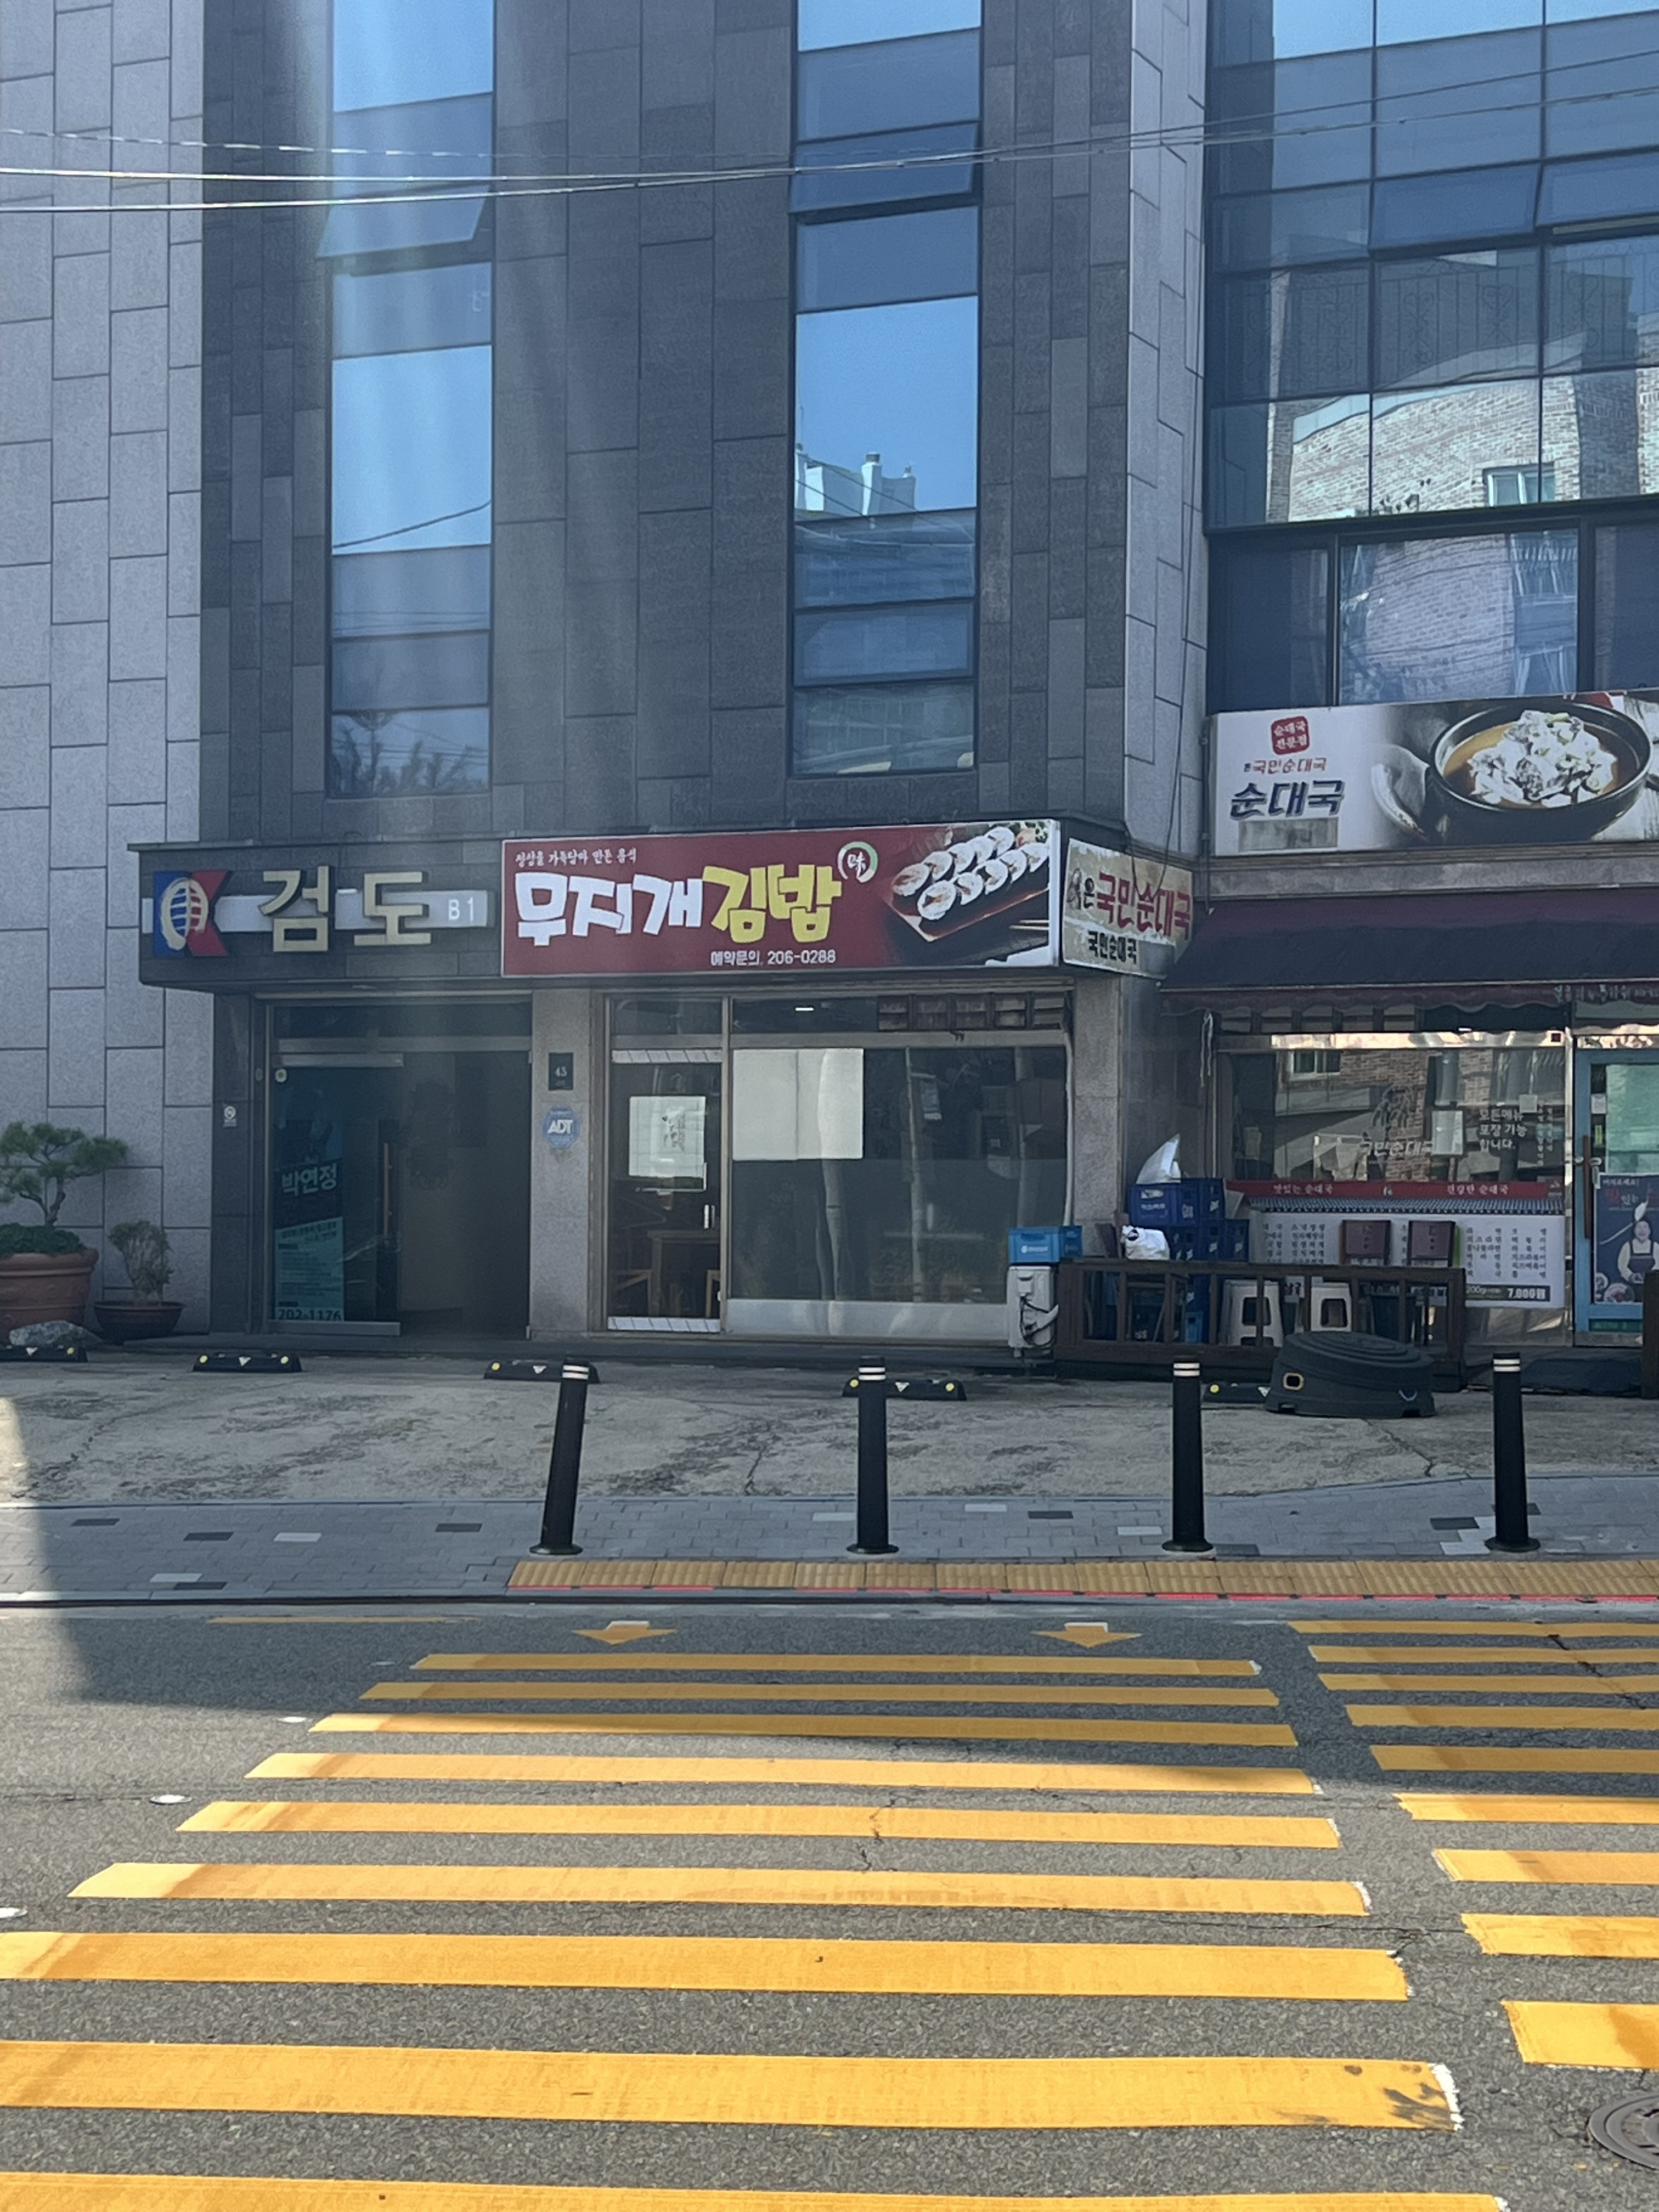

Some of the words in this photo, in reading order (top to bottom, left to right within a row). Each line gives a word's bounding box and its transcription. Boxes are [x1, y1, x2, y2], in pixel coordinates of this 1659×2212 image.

[1253, 757, 1327, 775] 국민순대국
[1230, 780, 1345, 820] 순대국
[258, 865, 432, 952] 검도
[448, 897, 475, 922] B1
[1097, 871, 1191, 941] 국민순대국
[768, 949, 837, 964] 206-0288
[548, 1119, 573, 1134] ADT
[1479, 1124, 1502, 1137] 포장
[281, 1163, 337, 1197] 박연정
